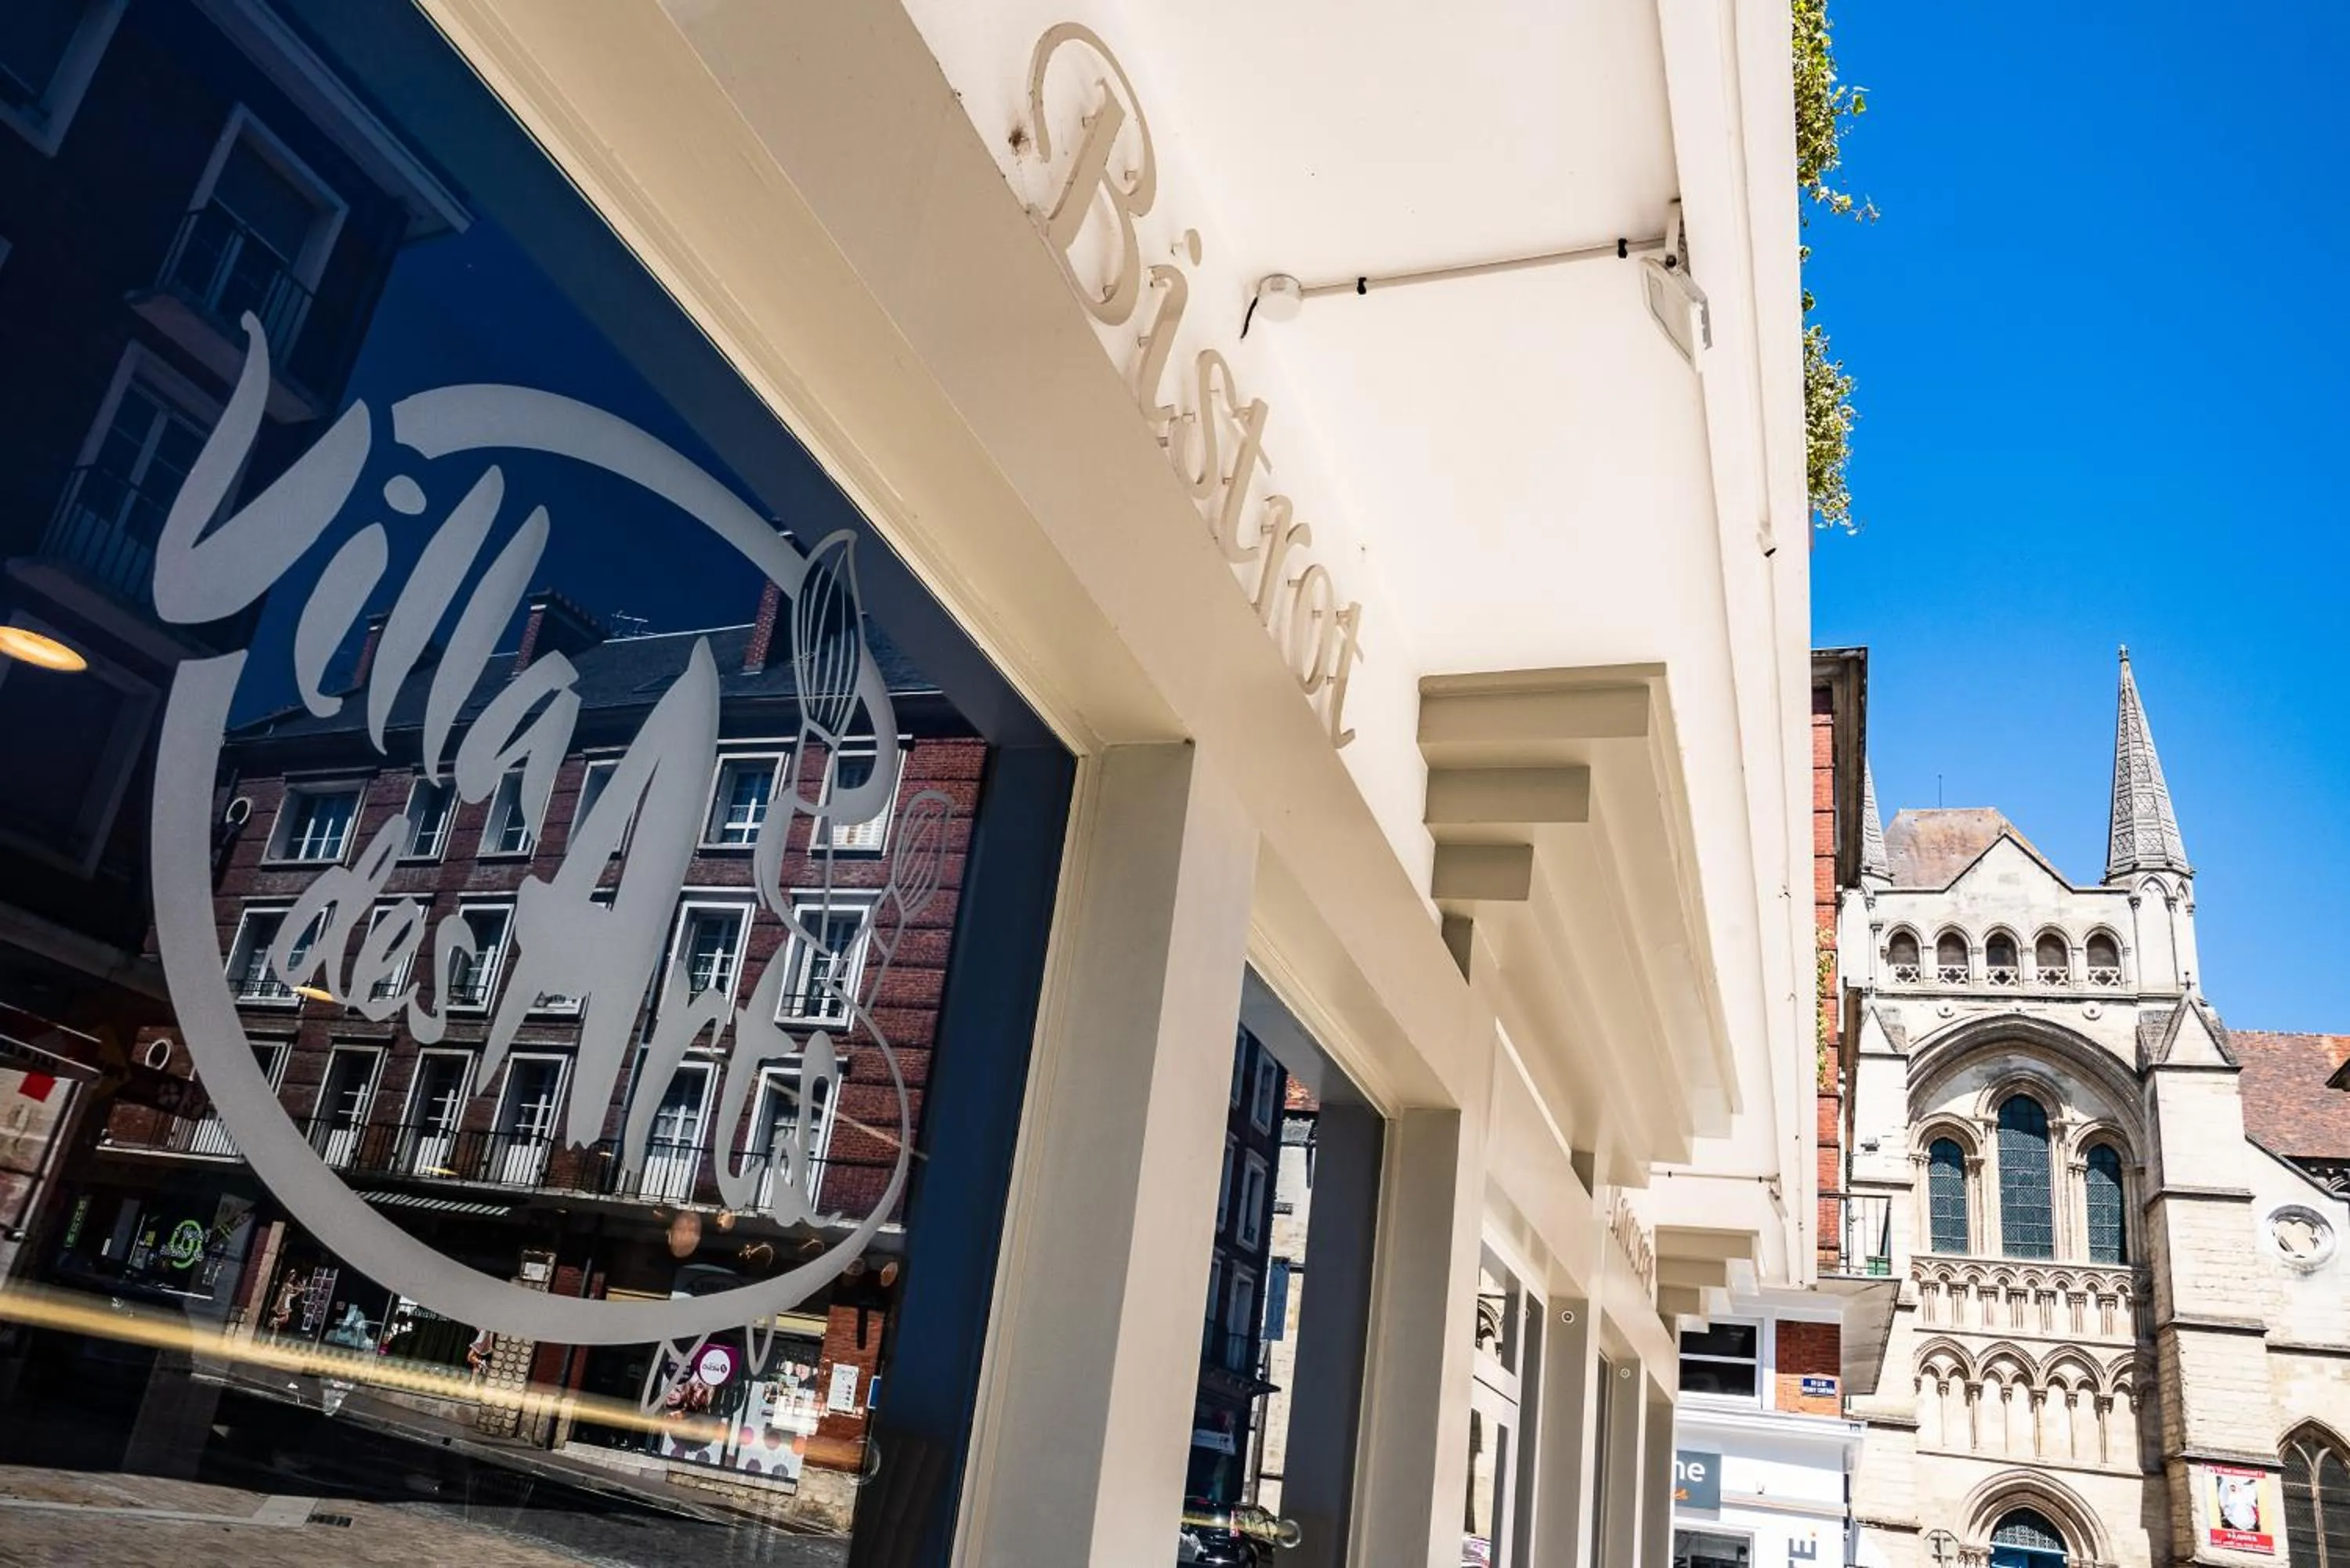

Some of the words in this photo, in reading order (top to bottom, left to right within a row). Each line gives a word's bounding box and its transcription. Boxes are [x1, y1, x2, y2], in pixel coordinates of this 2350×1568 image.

[154, 310, 580, 844] Villa
[1027, 21, 1364, 749] Bistrot
[272, 812, 476, 1046] des
[474, 635, 842, 1228] Arts
